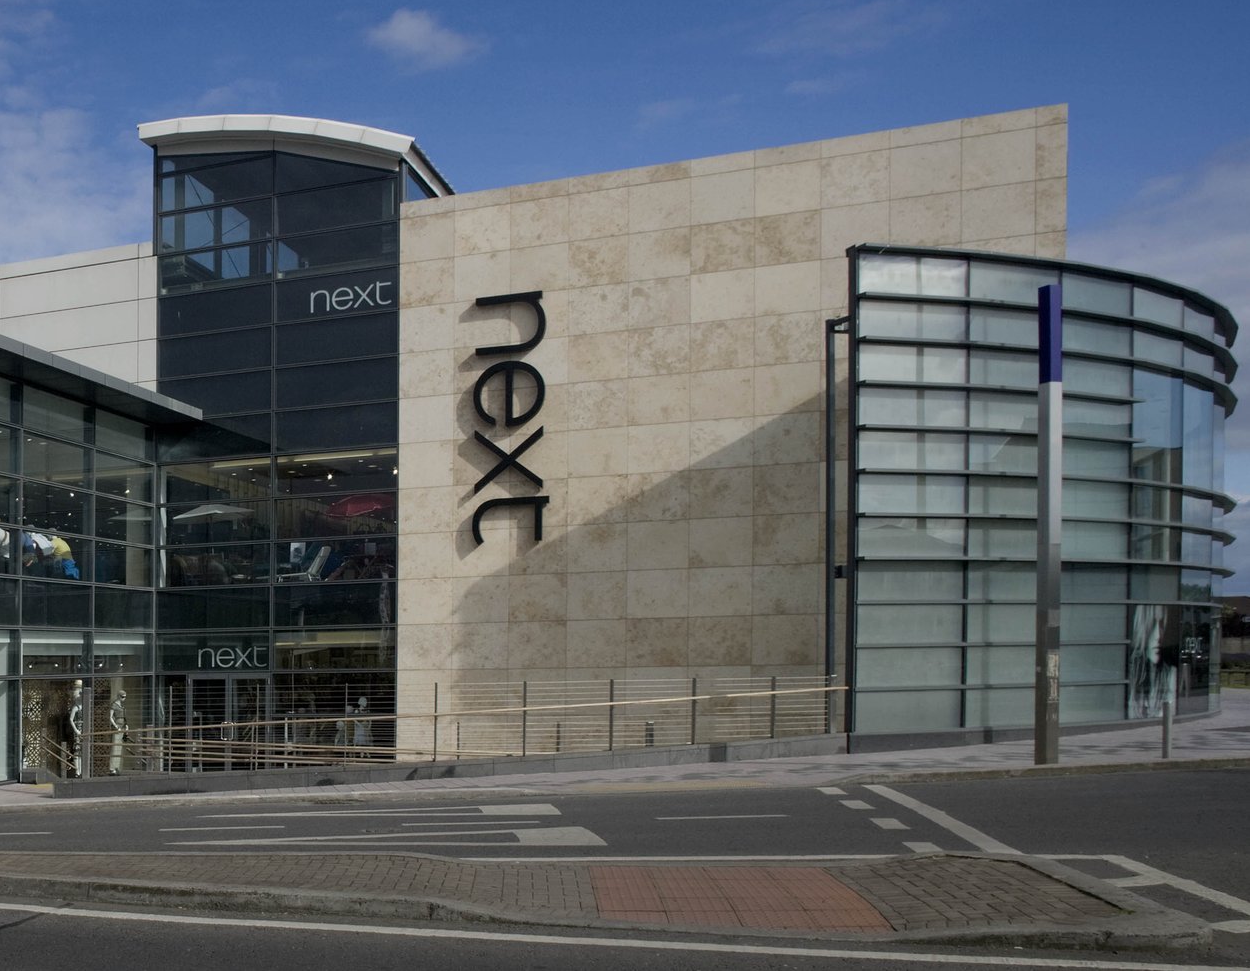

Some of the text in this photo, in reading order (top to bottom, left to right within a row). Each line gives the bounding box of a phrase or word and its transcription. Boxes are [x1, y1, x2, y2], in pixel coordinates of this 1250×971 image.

[310, 281, 392, 313] next
[472, 290, 549, 546] next
[197, 645, 267, 668] next
